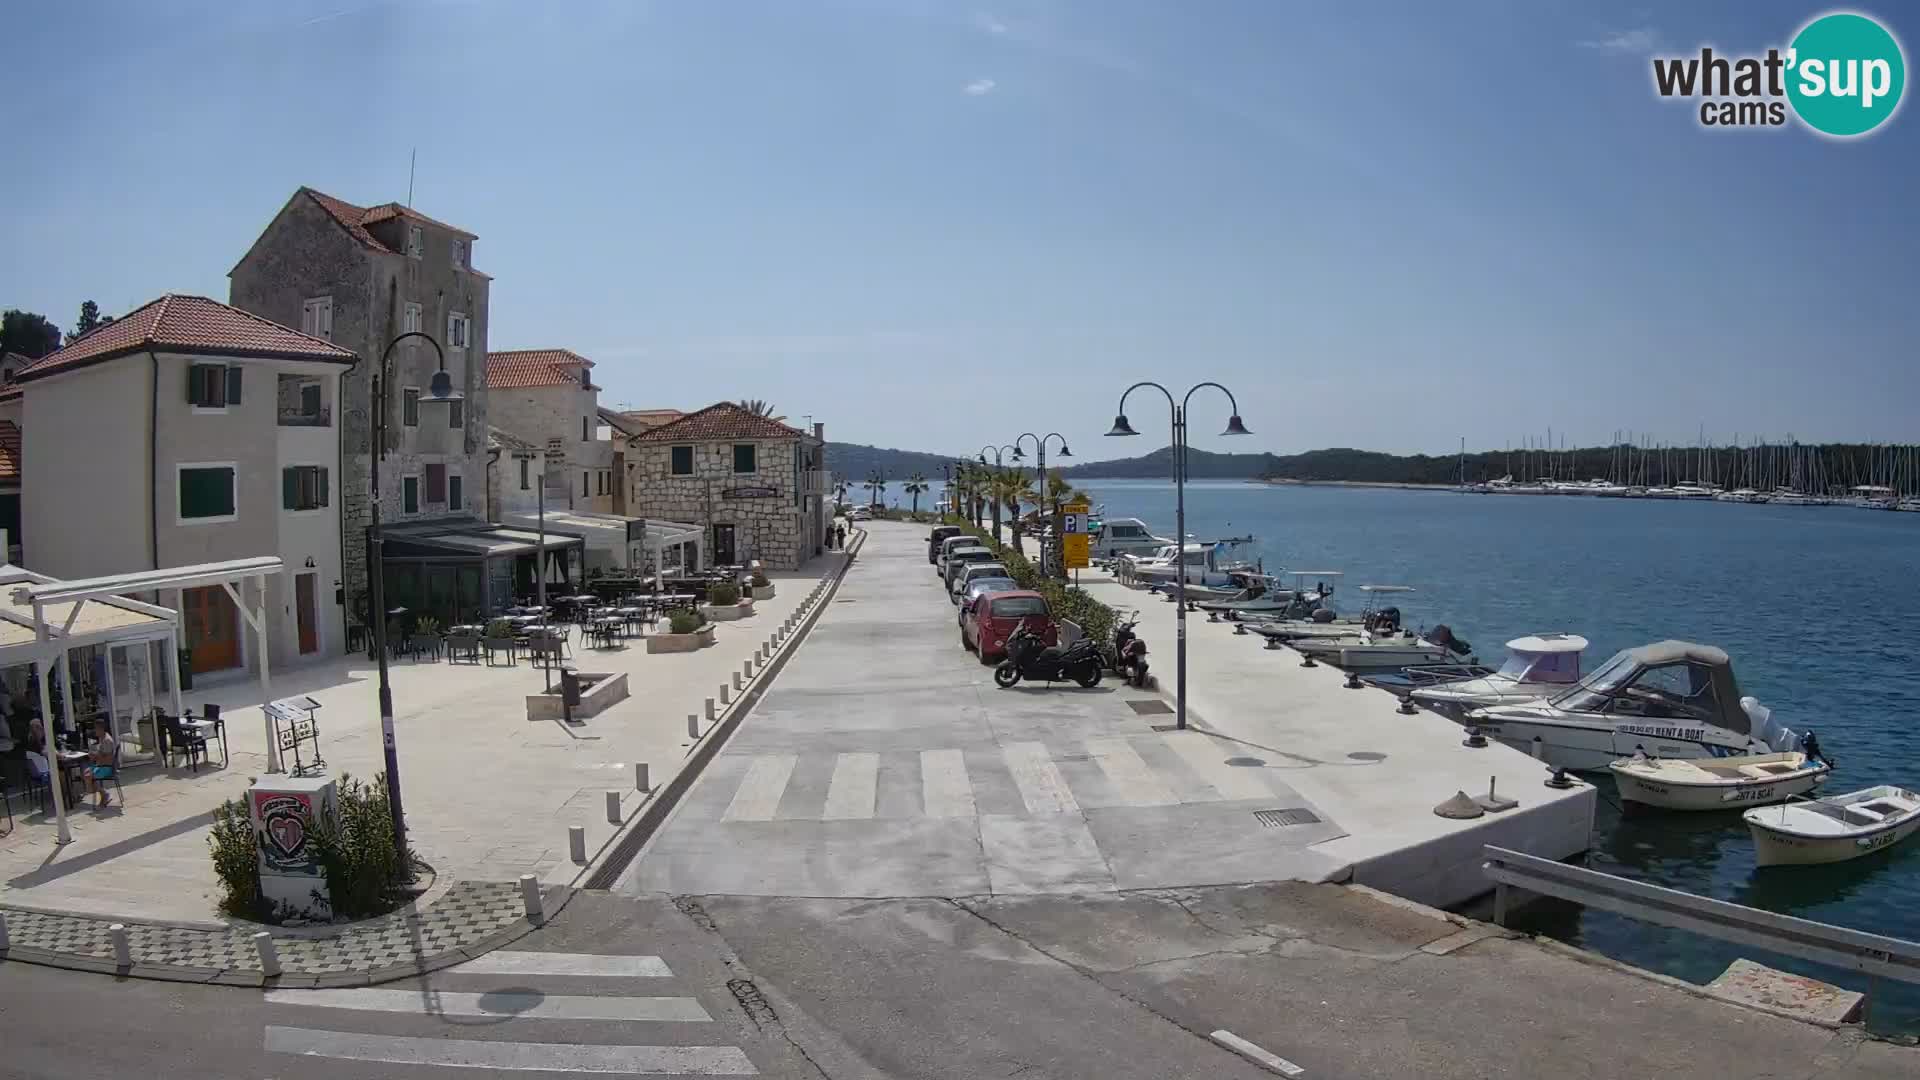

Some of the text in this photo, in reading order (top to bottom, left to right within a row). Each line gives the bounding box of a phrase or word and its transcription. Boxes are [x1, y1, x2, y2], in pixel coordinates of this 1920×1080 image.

[1065, 516, 1075, 531] P
[1656, 727, 1677, 737] RENT
[1678, 727, 1683, 738] A
[1685, 728, 1705, 741] BOAT
[1757, 788, 1775, 800] BOAT
